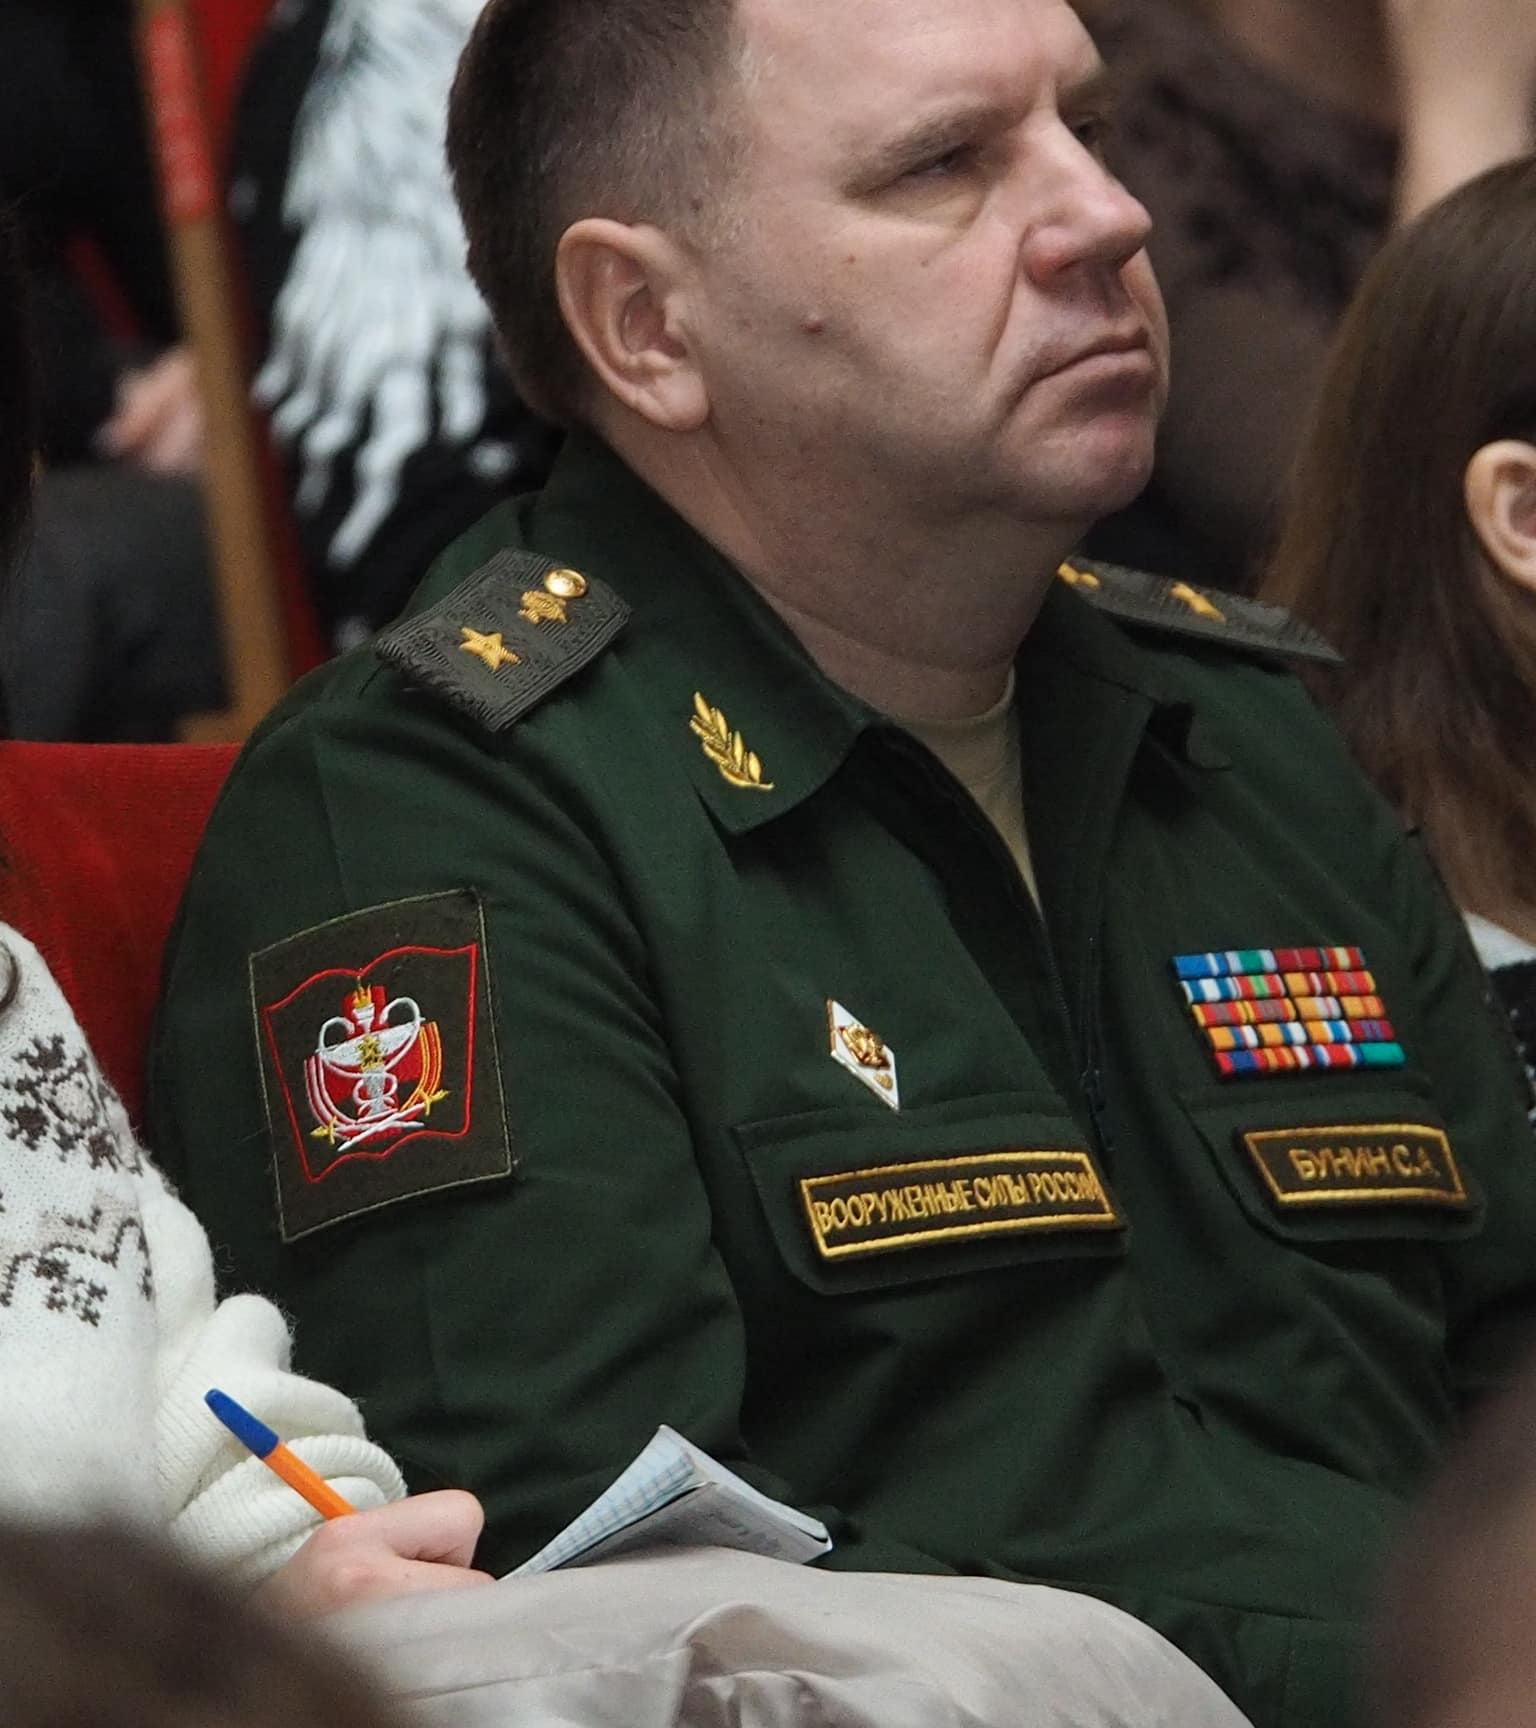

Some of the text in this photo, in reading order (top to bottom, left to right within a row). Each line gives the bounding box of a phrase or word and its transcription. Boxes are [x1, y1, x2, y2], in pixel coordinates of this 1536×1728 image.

[1289, 1146, 1391, 1181] БУНИН
[814, 1171, 1099, 1234] ВООРУЖЕННЫЕ СИЛЫ РОССИИ
